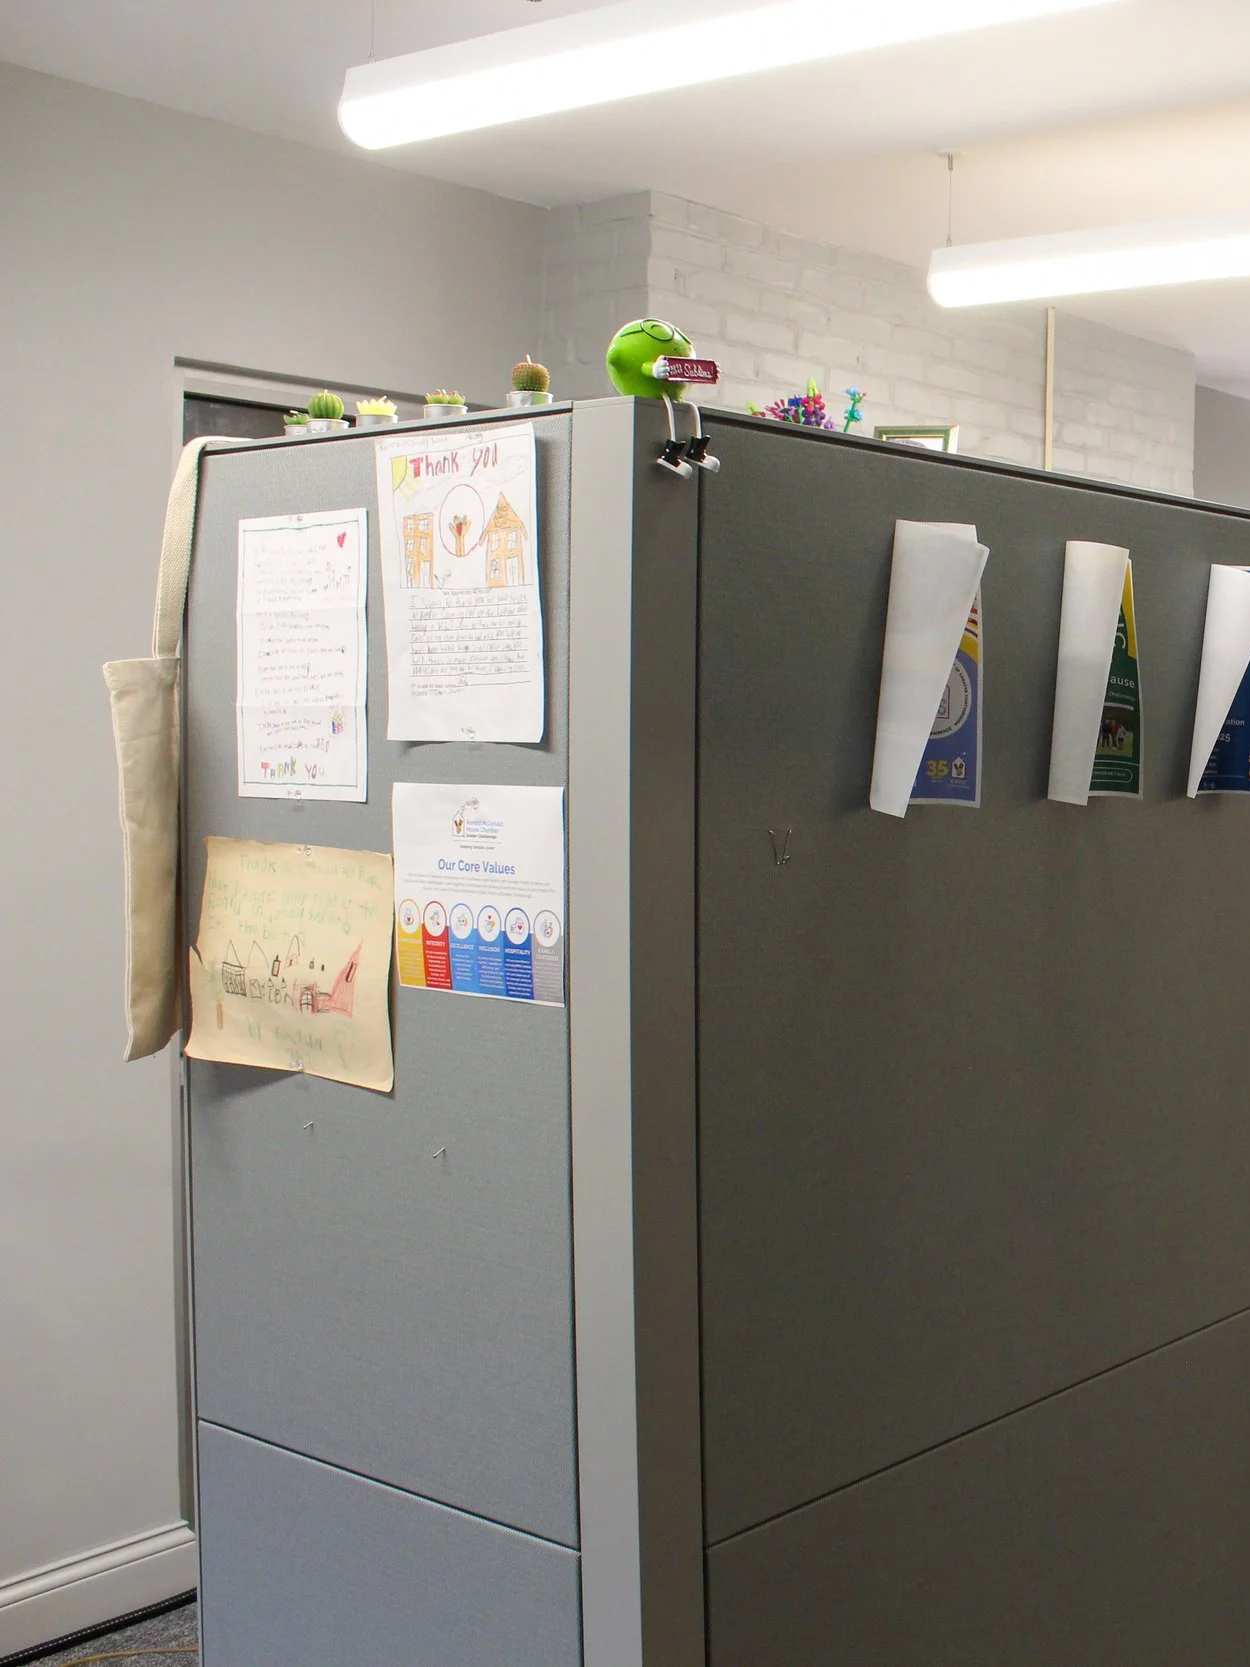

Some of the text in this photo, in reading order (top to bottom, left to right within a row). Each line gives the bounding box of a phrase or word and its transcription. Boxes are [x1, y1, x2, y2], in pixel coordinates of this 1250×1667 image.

[409, 451, 460, 479] Thank
[1110, 675, 1137, 689] ause.
[1226, 718, 1245, 726] ation
[261, 757, 297, 778] THANK
[927, 760, 949, 777] 35
[438, 858, 515, 875] Our Core Values
